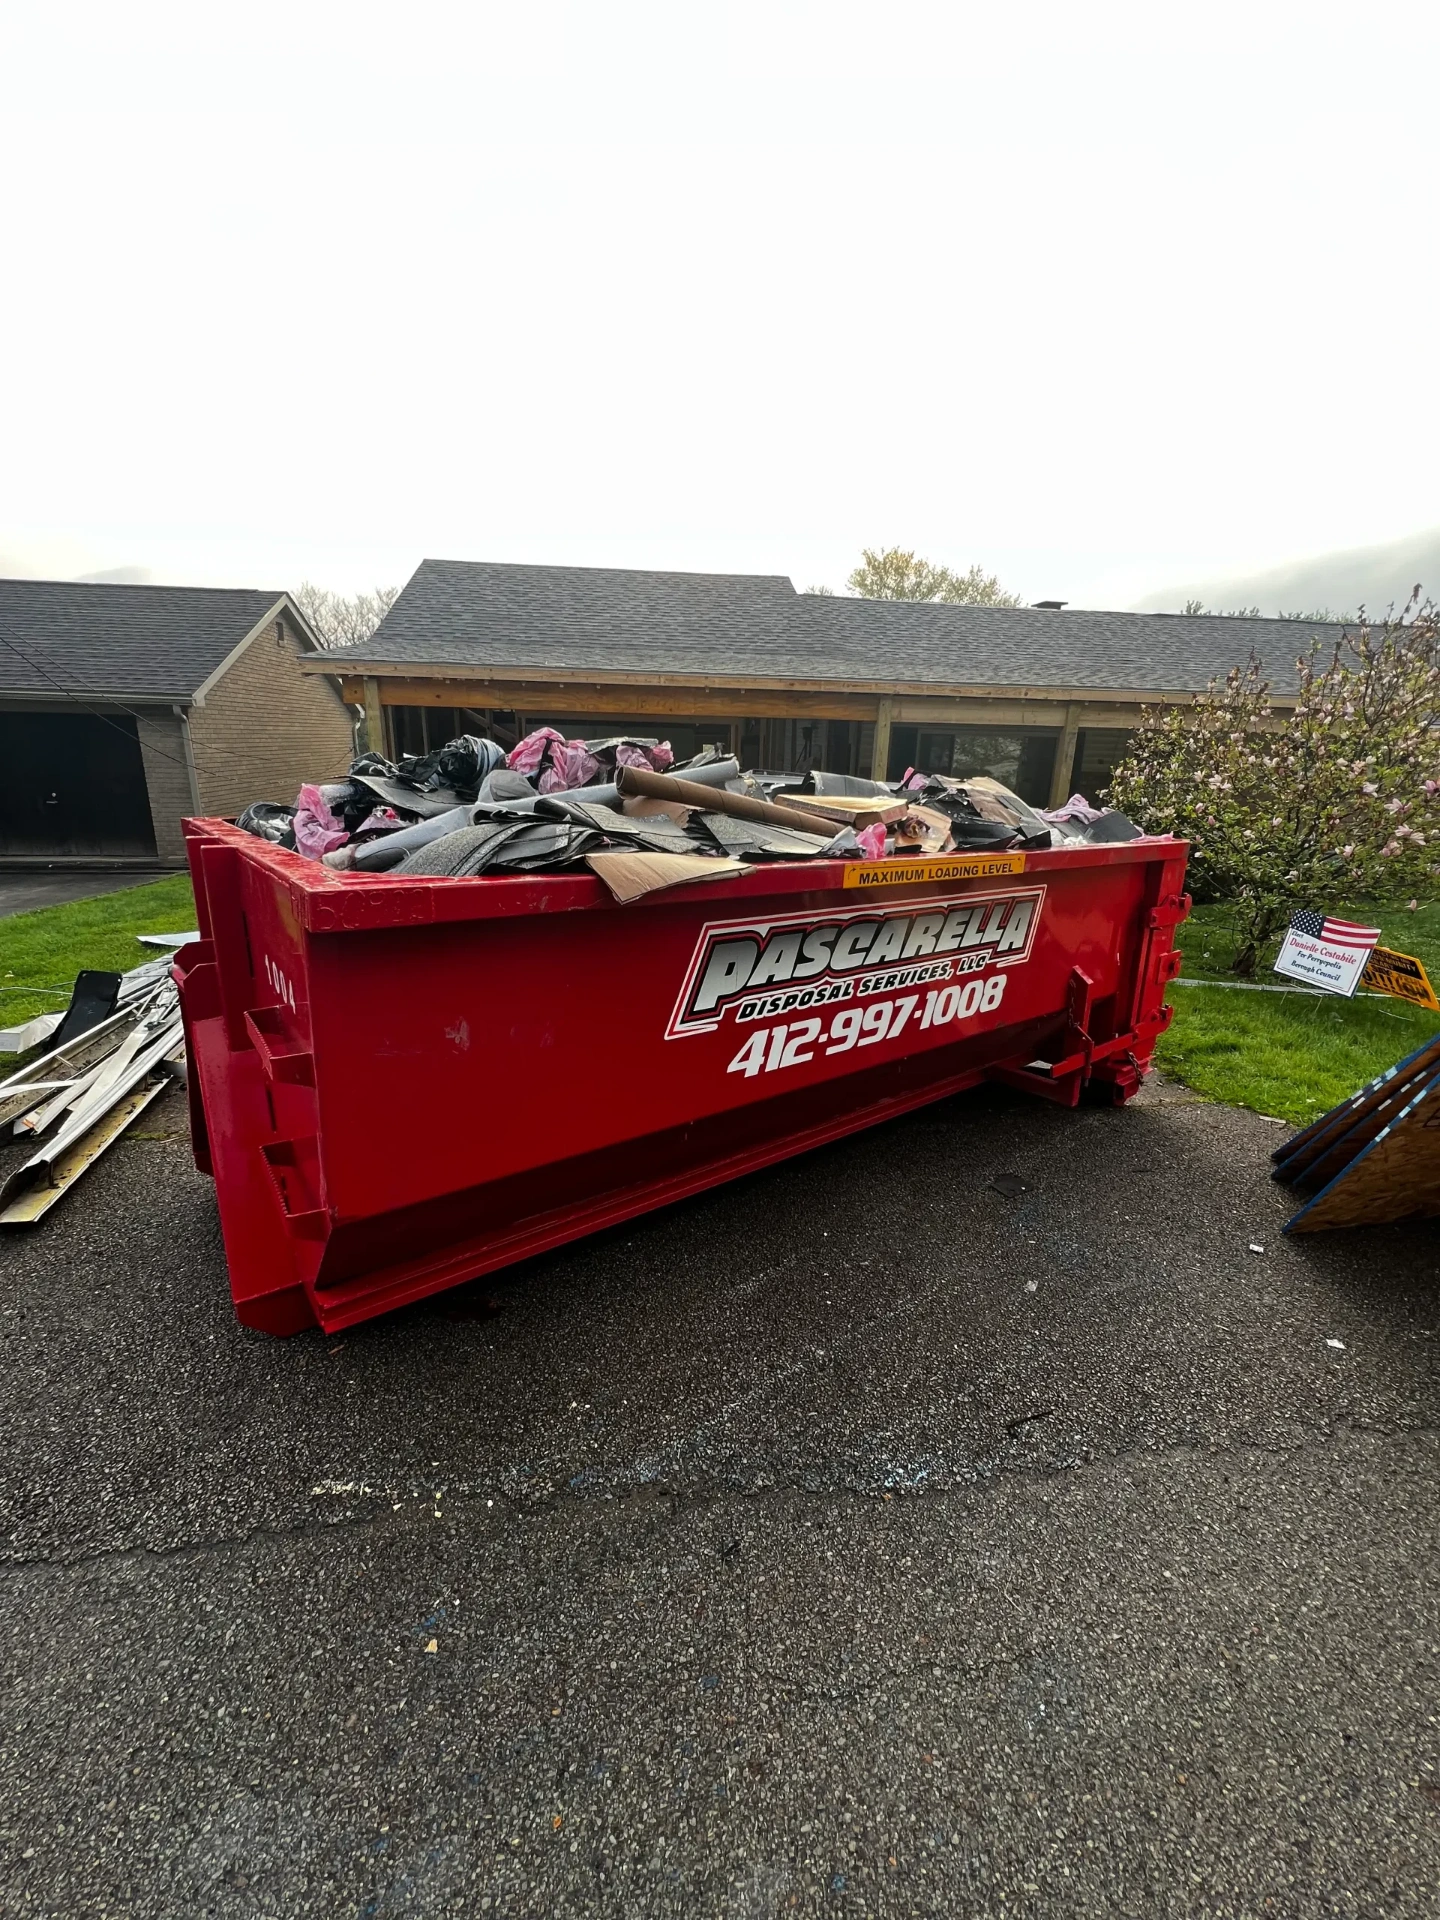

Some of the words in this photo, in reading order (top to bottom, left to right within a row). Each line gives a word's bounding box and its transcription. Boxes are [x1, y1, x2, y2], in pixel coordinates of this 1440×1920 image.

[858, 869, 925, 886] MAXIMUM
[928, 864, 980, 881] LOADING
[982, 861, 1014, 876] LEVEL
[1291, 930, 1304, 939] Elect
[692, 901, 1037, 1013] PASCARELLA
[1289, 937, 1319, 954] Danielle
[1320, 947, 1357, 965] Costabile
[1296, 950, 1307, 959] For
[1307, 953, 1342, 970] Perryopolis
[1290, 959, 1315, 973] Borough
[1315, 968, 1342, 981] Council
[264, 953, 297, 1016] 1004
[738, 981, 853, 1019] DISPOSAL
[859, 960, 954, 997] SERVICES,
[957, 952, 990, 976] LLC
[726, 974, 1008, 1079] 412-997-1008
